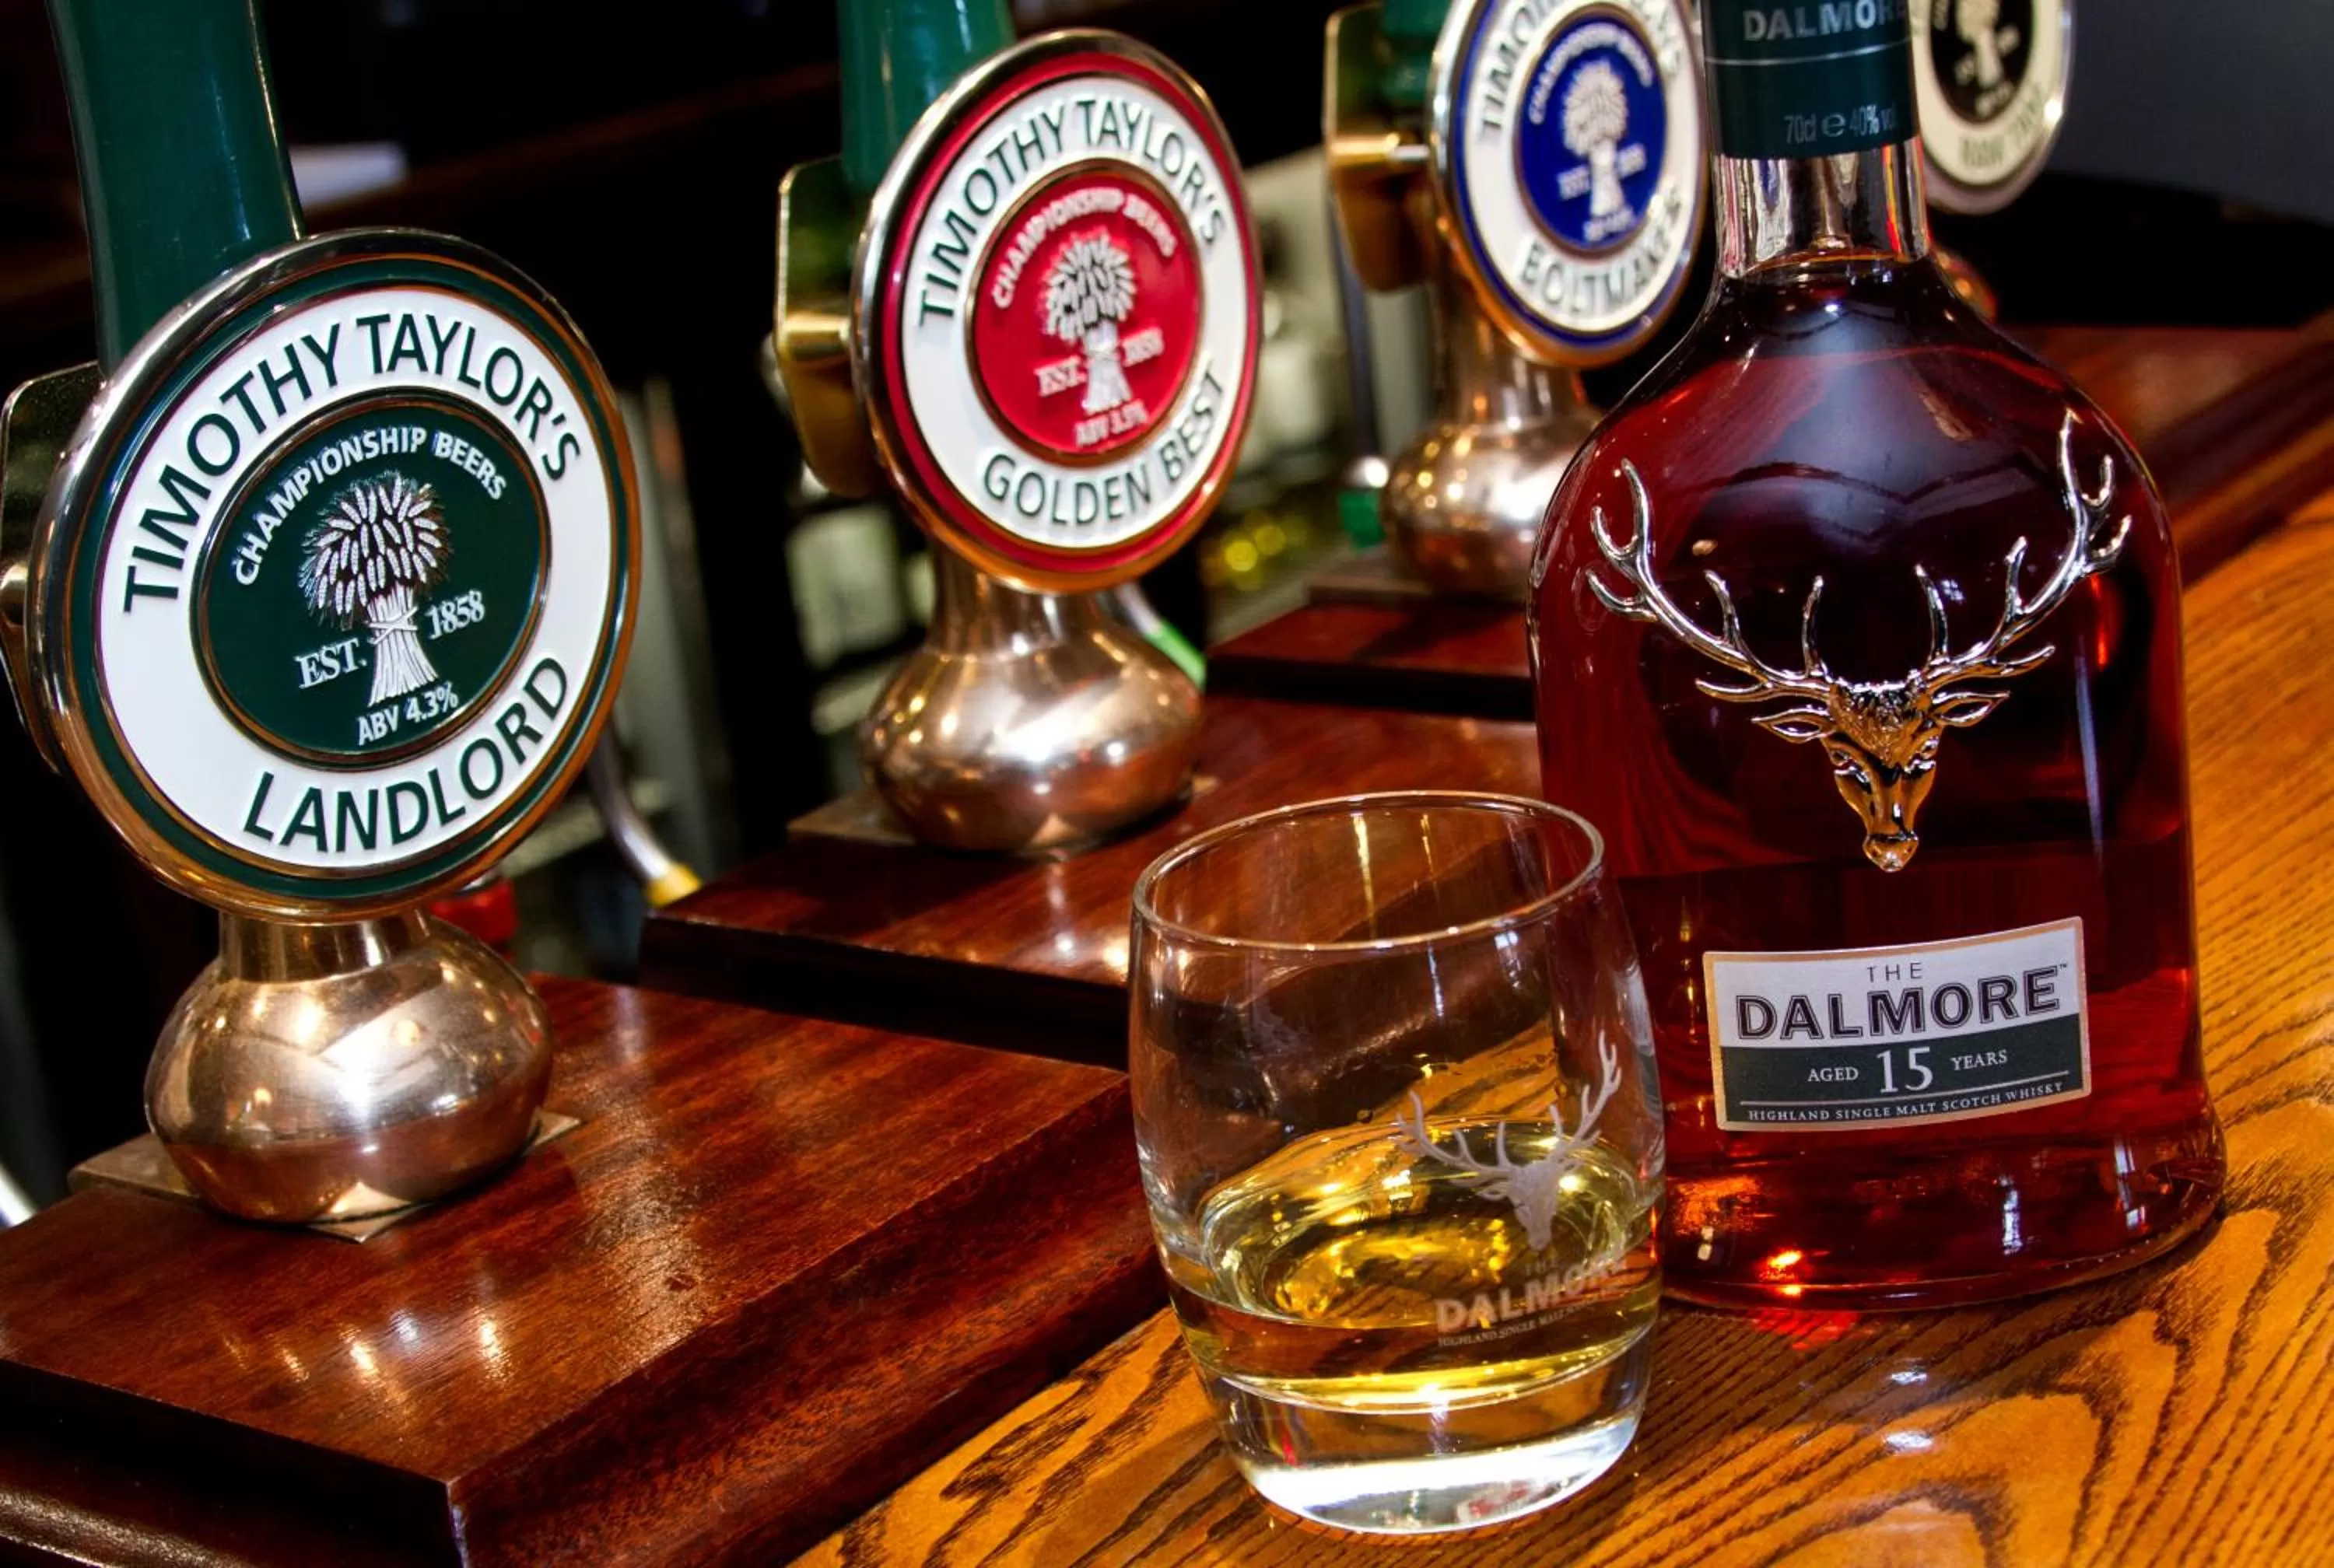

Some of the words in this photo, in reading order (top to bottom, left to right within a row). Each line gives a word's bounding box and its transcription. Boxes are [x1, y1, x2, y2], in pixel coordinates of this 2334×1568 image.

[1481, 0, 1554, 137] TIMO
[1784, 114, 1817, 144] 70cl
[919, 104, 1067, 327] TIMOTHY
[1076, 99, 1228, 247] TAYLOR'S
[123, 324, 341, 614] TIMOTHY
[357, 313, 580, 482] TAYLOR'S
[983, 453, 1152, 526] GOLDEN
[1159, 358, 1224, 484] BEST
[235, 427, 427, 586] CHAMPIONSHIP
[433, 432, 506, 500] BEERS
[294, 638, 368, 688] EST.
[425, 589, 485, 639] 1858
[241, 656, 569, 853] LANDLORD
[356, 708, 399, 746] ABV
[405, 682, 459, 723] 4.3%
[1867, 962, 1922, 983] THE
[1748, 1110, 1829, 1121] HIGHLAND
[1835, 1107, 1891, 1119] SINGLE
[1897, 1103, 1935, 1116] MALT
[1943, 1094, 2000, 1111] SCOTCH
[2006, 1082, 2063, 1101] WHISKY
[1807, 1067, 1859, 1083] AGED
[1876, 1046, 1934, 1094] 15
[1950, 1050, 2007, 1071] YEARS
